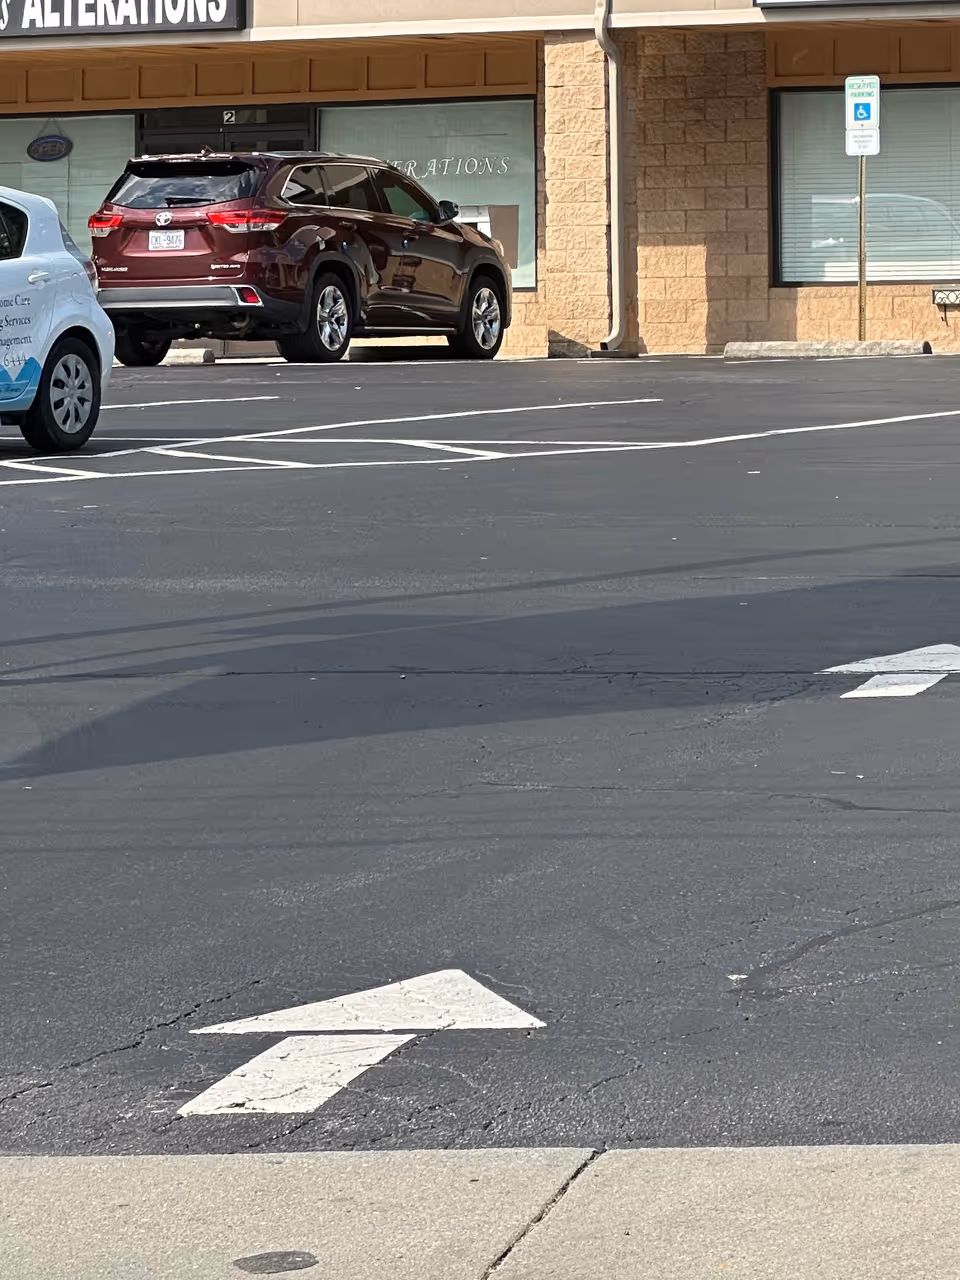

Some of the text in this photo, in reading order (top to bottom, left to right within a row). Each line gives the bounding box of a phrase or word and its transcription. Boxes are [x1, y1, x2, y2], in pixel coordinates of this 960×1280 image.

[224, 111, 234, 123] 2
[15, 294, 31, 306] Care
[5, 314, 31, 327] Services
